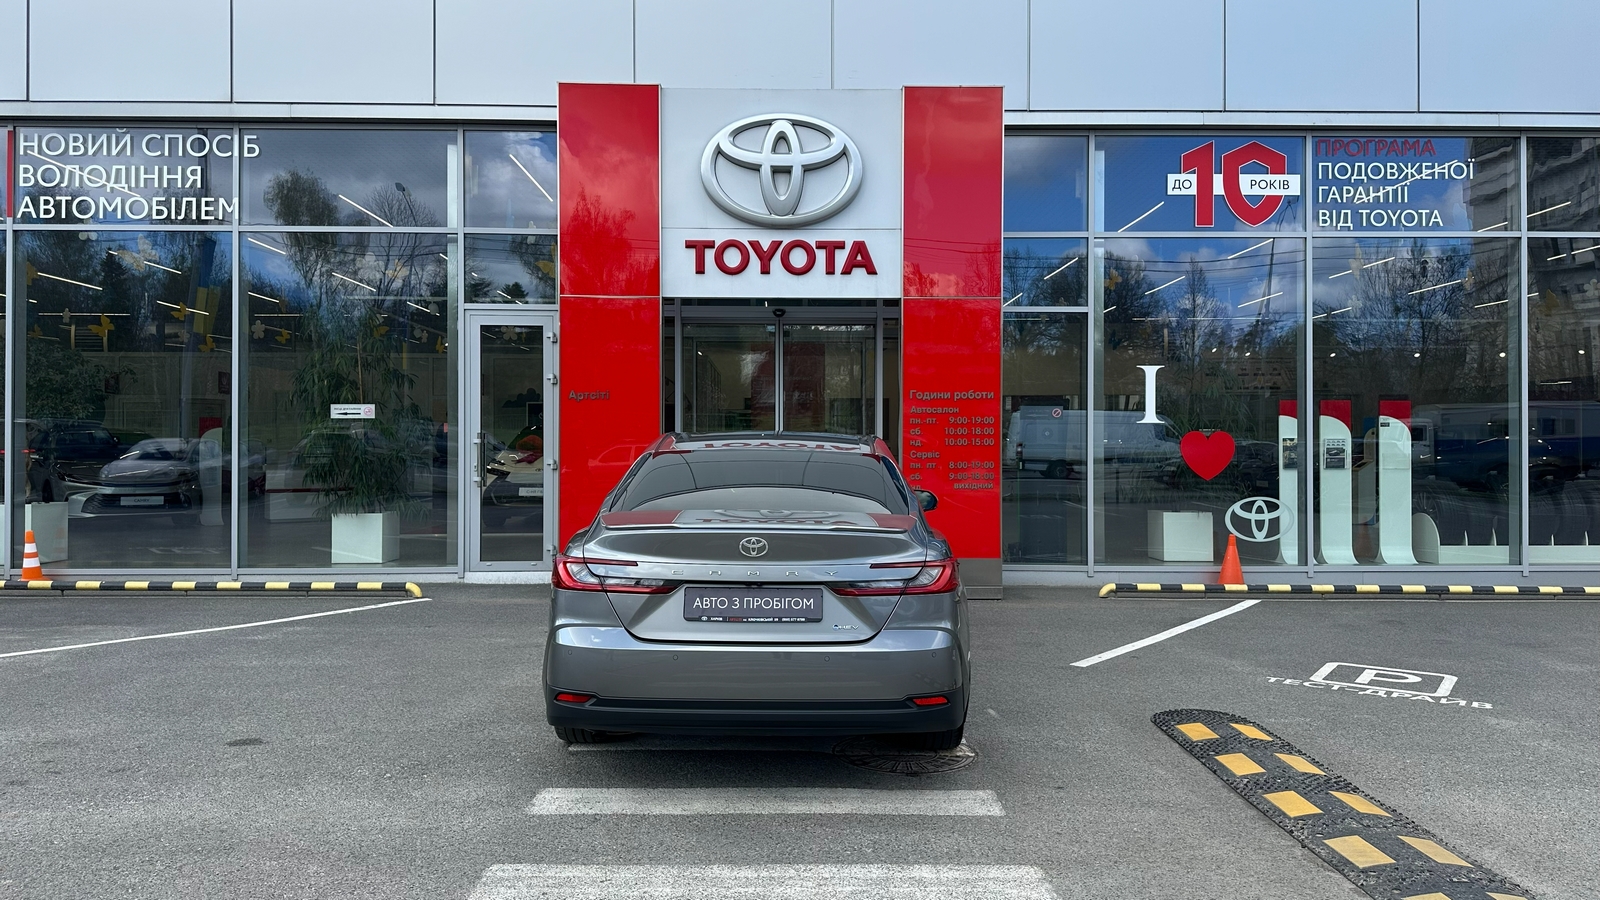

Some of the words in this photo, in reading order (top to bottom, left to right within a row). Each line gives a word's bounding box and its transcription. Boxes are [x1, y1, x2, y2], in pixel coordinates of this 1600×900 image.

[19, 128, 131, 156] НОВИЙ
[141, 133, 260, 158] СПОСІБ
[1316, 138, 1437, 156] ПРОГРАМА
[1317, 158, 1476, 183] ПОДОВЖЕНОЇ
[18, 164, 202, 192] ВОЛОДІННЯ
[1172, 178, 1193, 191] ДО
[1181, 140, 1288, 228] 10
[1250, 179, 1290, 190] РОКІВ
[1317, 183, 1411, 203] ГАРАНТІЇ
[16, 195, 239, 220] АВТОМОБІЛЕМ
[1318, 209, 1354, 230] ВІД
[1358, 209, 1444, 227] TOYOTA
[684, 238, 878, 276] TOYOTA
[568, 389, 610, 403] Артсіті
[909, 389, 951, 400] Години
[953, 389, 995, 401] роботи
[1136, 365, 1166, 424] I
[909, 406, 960, 414] Автосалон
[948, 416, 995, 425] 9:00-19:00
[909, 427, 924, 435] сб.
[944, 427, 995, 435] 10:00-18:00
[909, 439, 924, 447] нд.
[944, 438, 995, 446] 10:00-15:00
[909, 450, 941, 460] Сервіс
[948, 461, 995, 469] 8:00-19:00
[909, 472, 923, 480] сб.
[948, 472, 995, 480] 9:00-18:00
[953, 481, 994, 490] вихідний
[671, 569, 838, 577] CAMRY
[693, 597, 729, 609] АВТО
[743, 597, 815, 610] ПРОБІГОМ
[1265, 676, 1494, 710] ТЕСТ-ДРАЙВ
